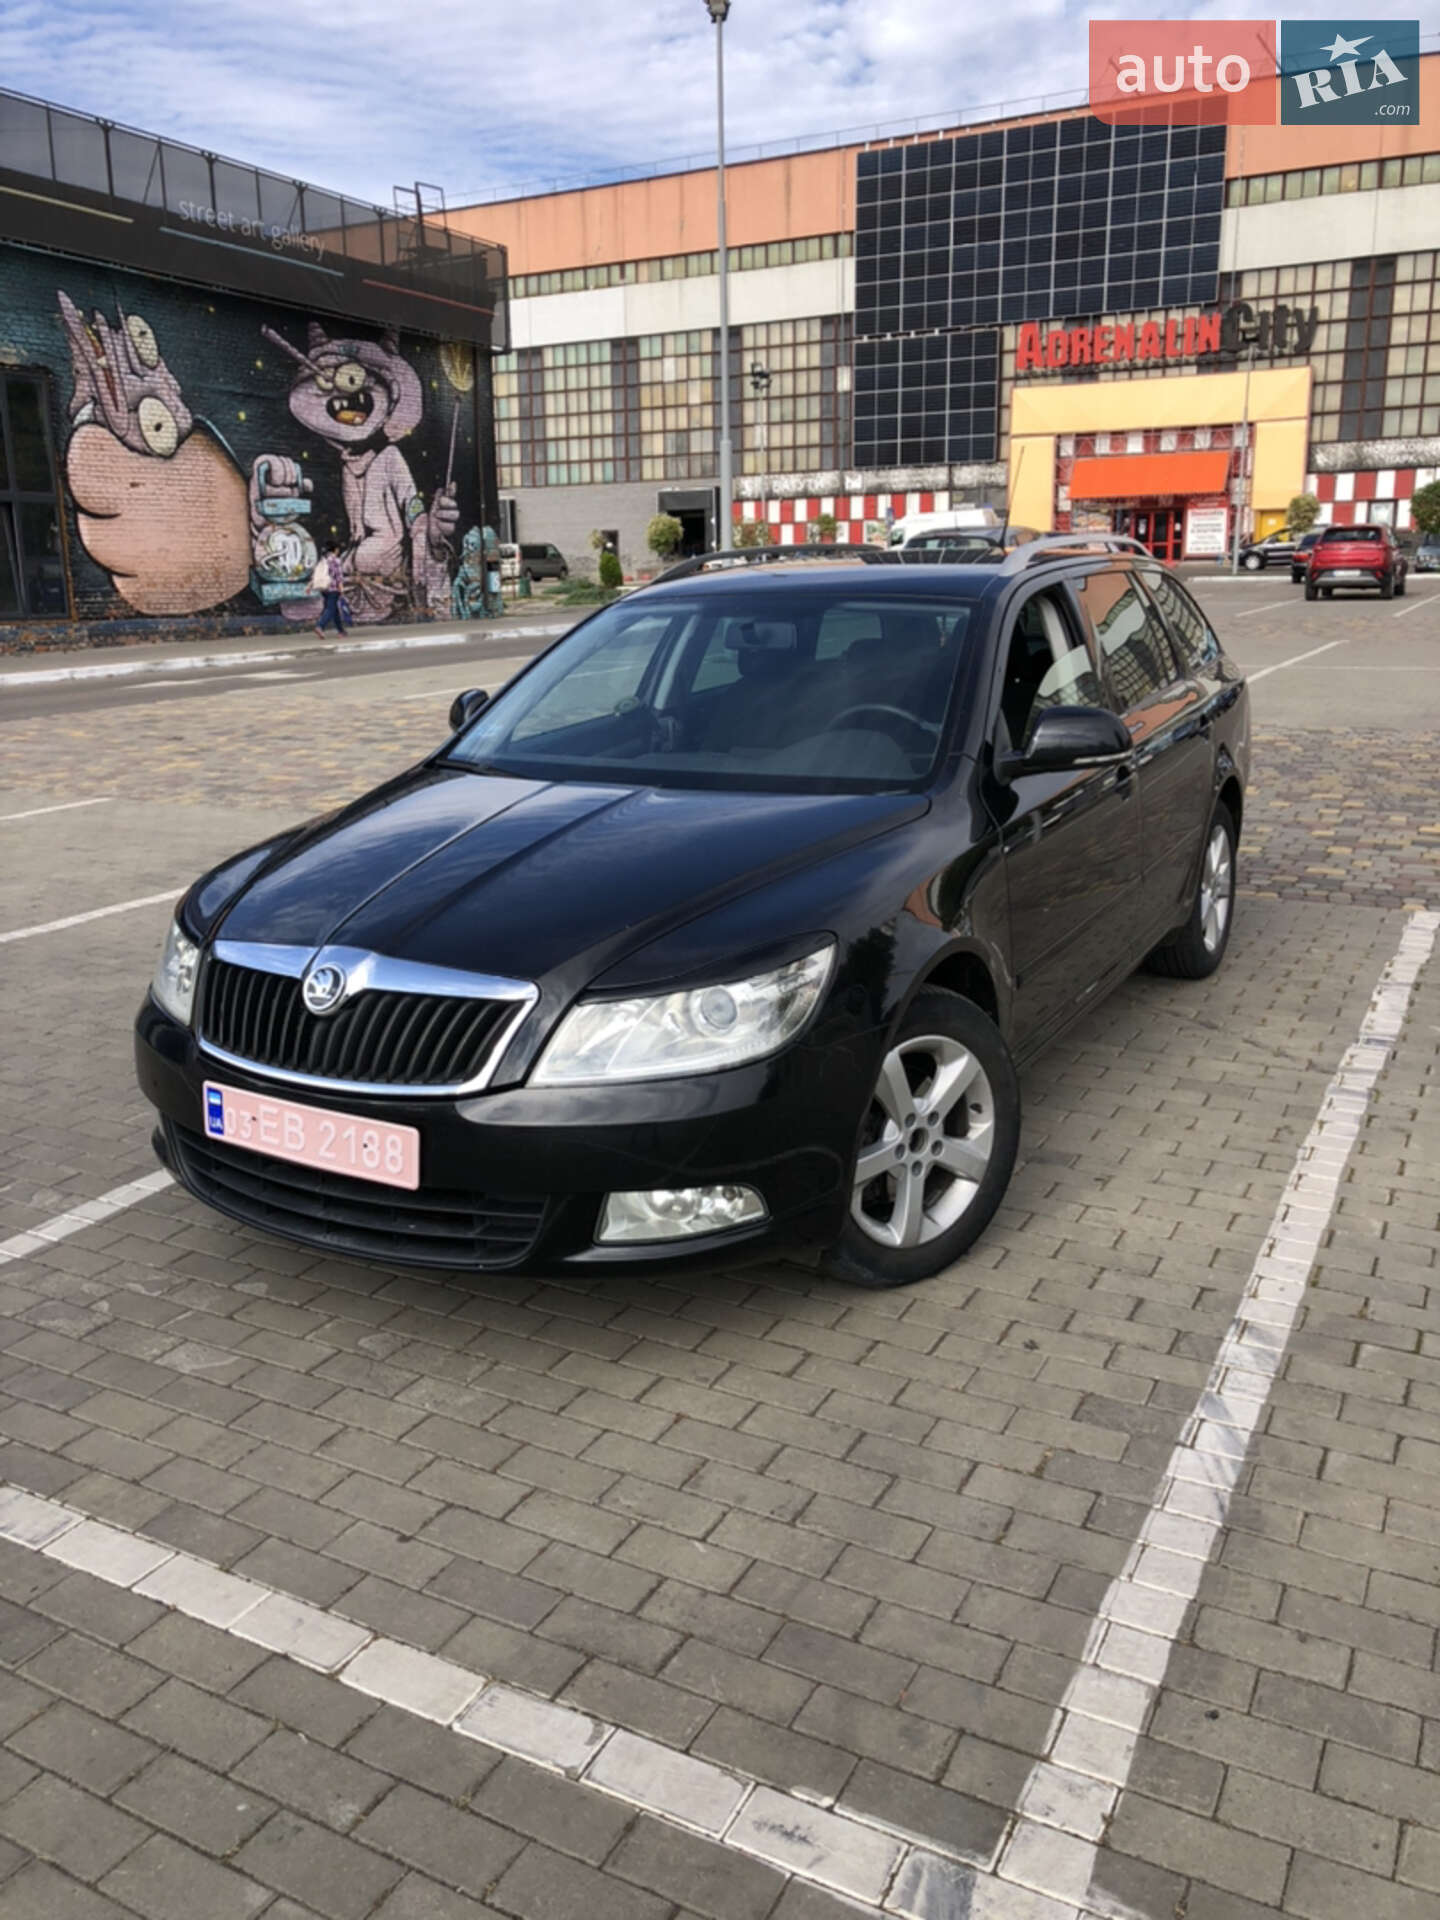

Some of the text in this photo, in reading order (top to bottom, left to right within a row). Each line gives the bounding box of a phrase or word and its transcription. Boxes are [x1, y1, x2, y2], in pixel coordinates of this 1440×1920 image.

[179, 200, 327, 262] street art gallery
[318, 1119, 404, 1175] 2188
